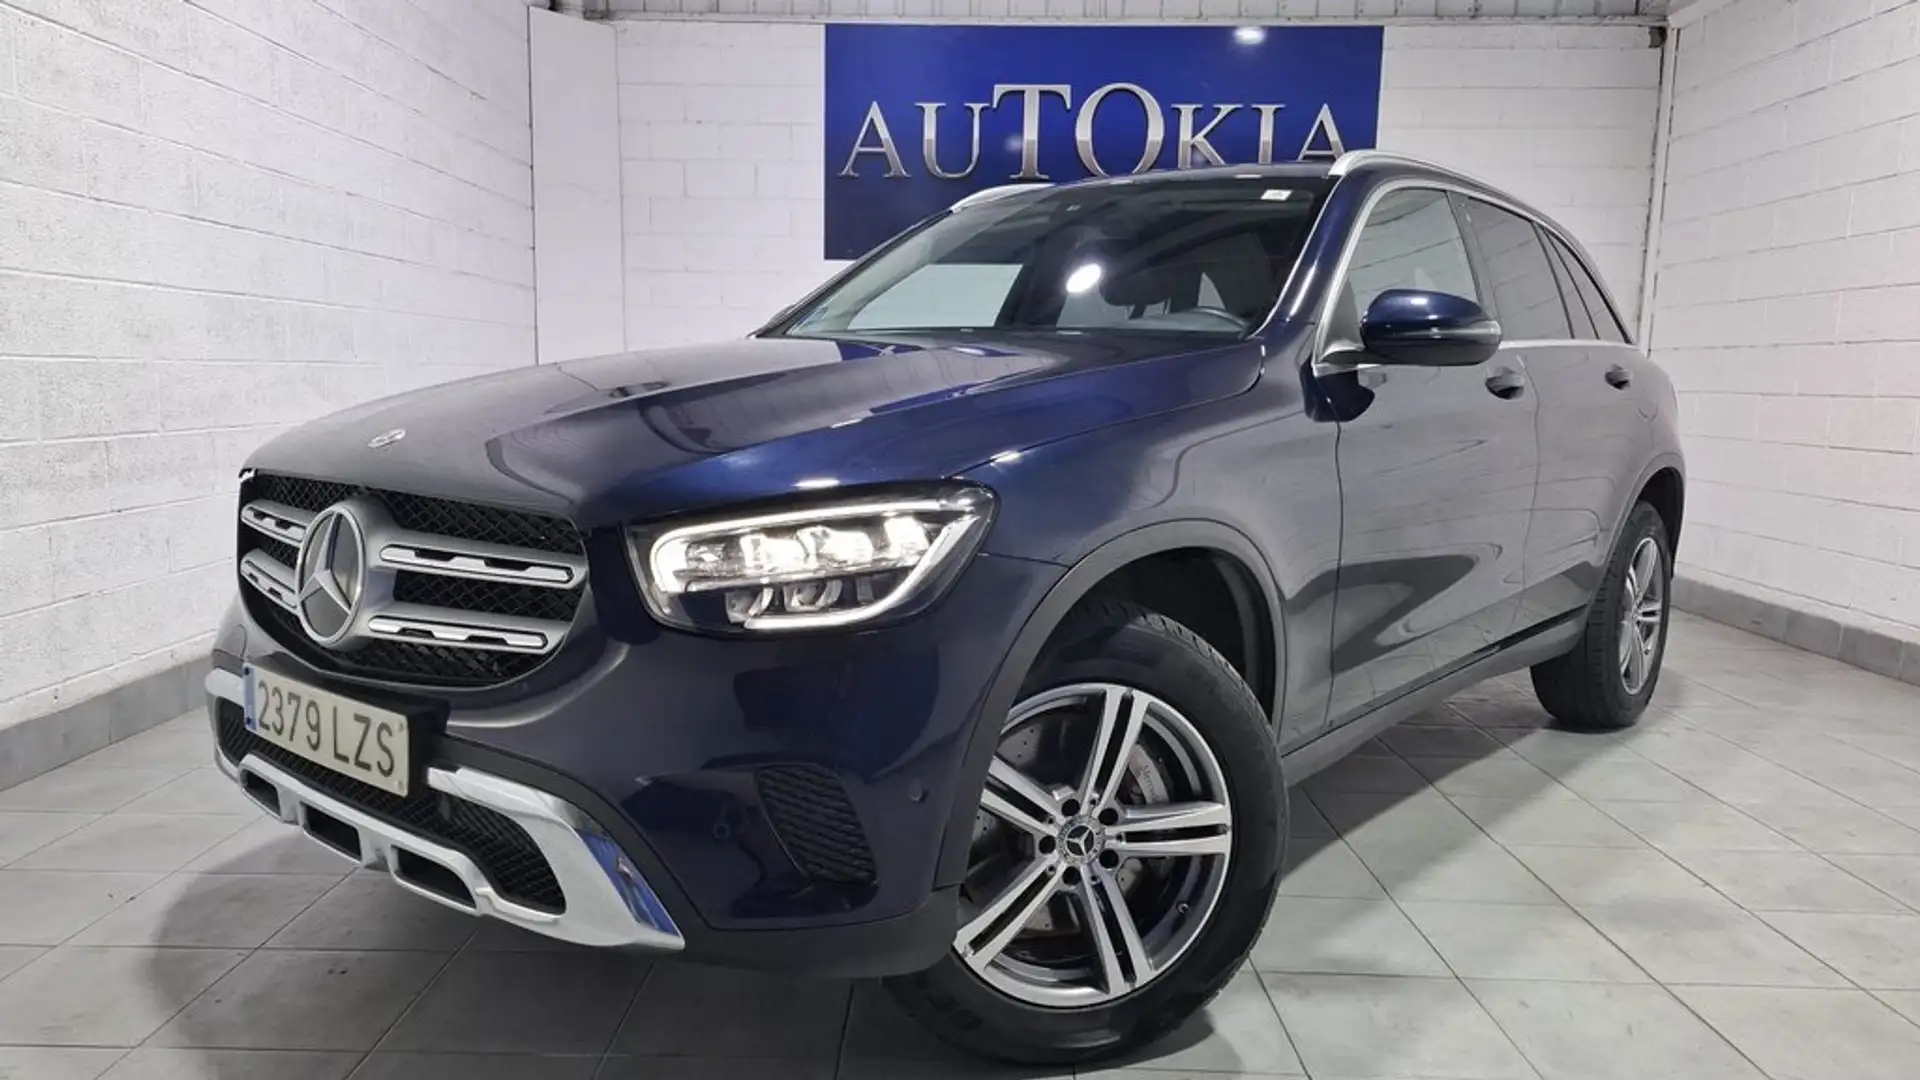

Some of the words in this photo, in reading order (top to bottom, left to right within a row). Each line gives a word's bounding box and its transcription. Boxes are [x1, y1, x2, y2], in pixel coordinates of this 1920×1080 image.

[838, 83, 1346, 178] AUTOKIA
[258, 680, 322, 751] 2379
[332, 706, 396, 777] LZS
